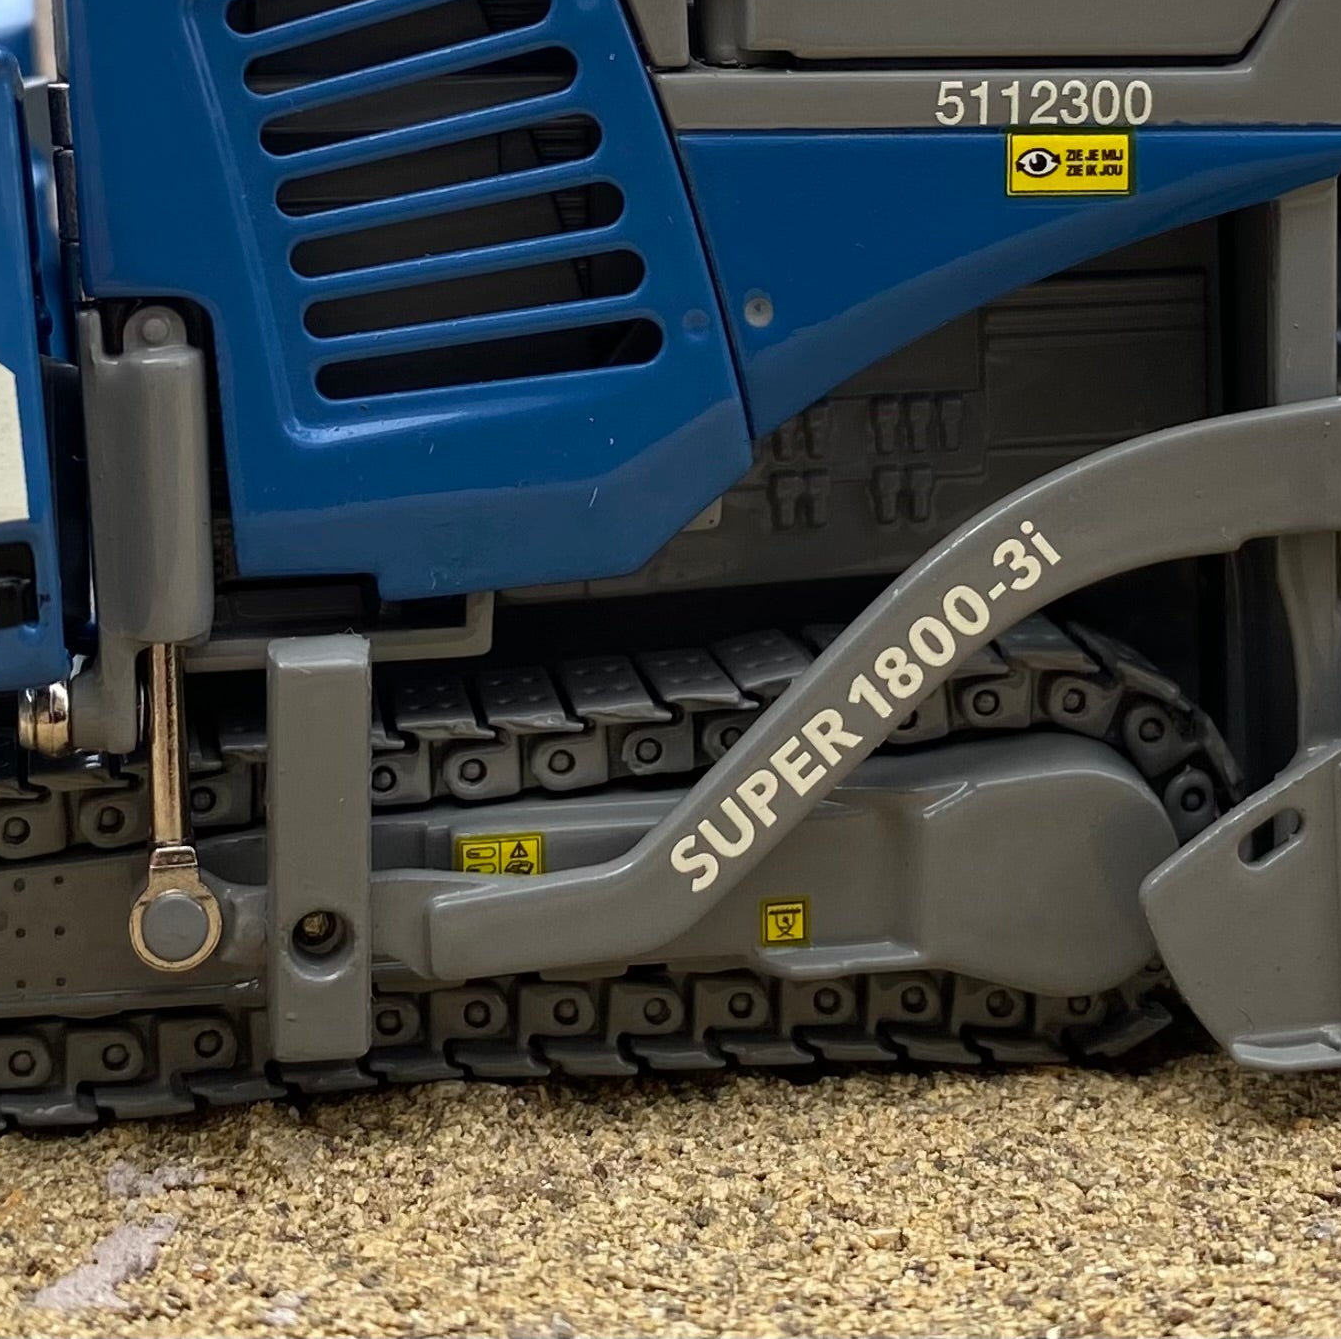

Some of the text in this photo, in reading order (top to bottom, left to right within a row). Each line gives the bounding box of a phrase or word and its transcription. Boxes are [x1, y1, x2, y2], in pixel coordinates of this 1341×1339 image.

[935, 79, 1153, 126] 5112300
[1065, 149, 1084, 162] ZIE
[1084, 149, 1100, 162] JE
[1065, 164, 1124, 177] ZIE IK JOU
[670, 520, 1062, 892] SUPER 1800-3i
